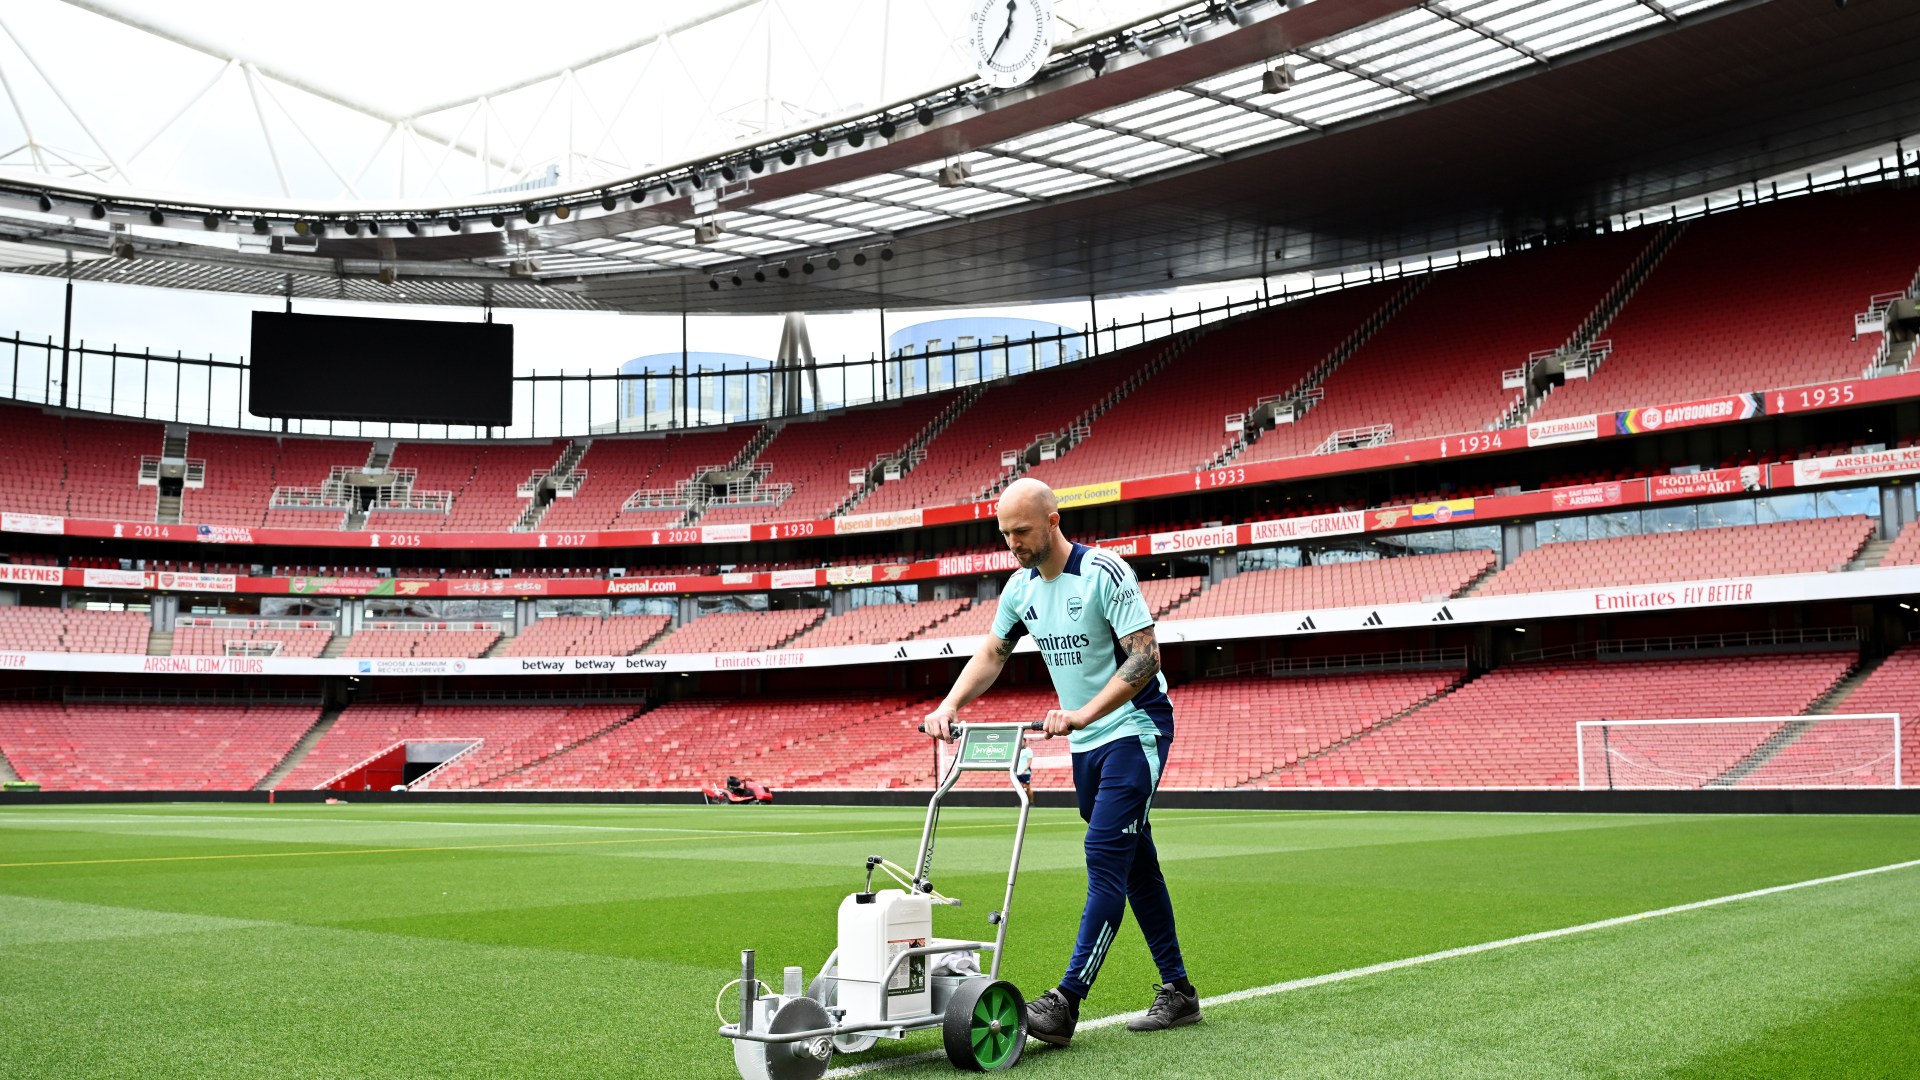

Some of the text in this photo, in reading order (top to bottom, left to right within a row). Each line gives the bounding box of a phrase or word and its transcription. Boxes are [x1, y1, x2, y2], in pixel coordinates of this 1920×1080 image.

[1046, 11, 1051, 21] 3
[970, 38, 975, 47] 9
[1031, 61, 1036, 70] 5
[993, 74, 997, 82] 7
[1012, 74, 1018, 83] 6
[1800, 386, 1855, 407] 1935
[1664, 401, 1734, 424] GAYGOONERS
[1540, 419, 1596, 435] AZERBAIJAN
[1459, 434, 1503, 453] 1934
[1835, 454, 1898, 468] ARSENAL
[1210, 469, 1246, 486] 1933
[1084, 488, 1118, 499] Gooners
[1655, 486, 1684, 496] SHOULD
[1684, 485, 1694, 493] BE
[1695, 484, 1707, 492] AN
[1569, 494, 1604, 506] ARSENAL
[784, 523, 814, 536] 1930
[837, 516, 873, 531] Arsenal
[1255, 514, 1361, 540] ARSENAL GERMANY
[135, 525, 170, 538] 2014
[208, 533, 253, 543] MALAYSIA
[211, 526, 250, 537] ARSENAL
[668, 531, 697, 543] 2020
[390, 535, 421, 547] 2015
[556, 535, 586, 547] 2017
[1173, 528, 1234, 550] Slovenia
[944, 556, 973, 575] HONG
[985, 551, 1015, 570] KONG
[12, 567, 60, 582] KEYNES
[607, 579, 677, 594] Arsenal.com
[1595, 583, 1753, 611] Emirates FLY BETTER
[144, 657, 264, 673] ARSENAL.COM/TOURS
[408, 660, 447, 668] ALUMINIUM
[575, 659, 615, 672] betway
[626, 658, 667, 672] betway
[715, 652, 804, 668] Emirates FLY BETTER
[1054, 651, 1083, 667] BETTER
[522, 660, 565, 673] betway
